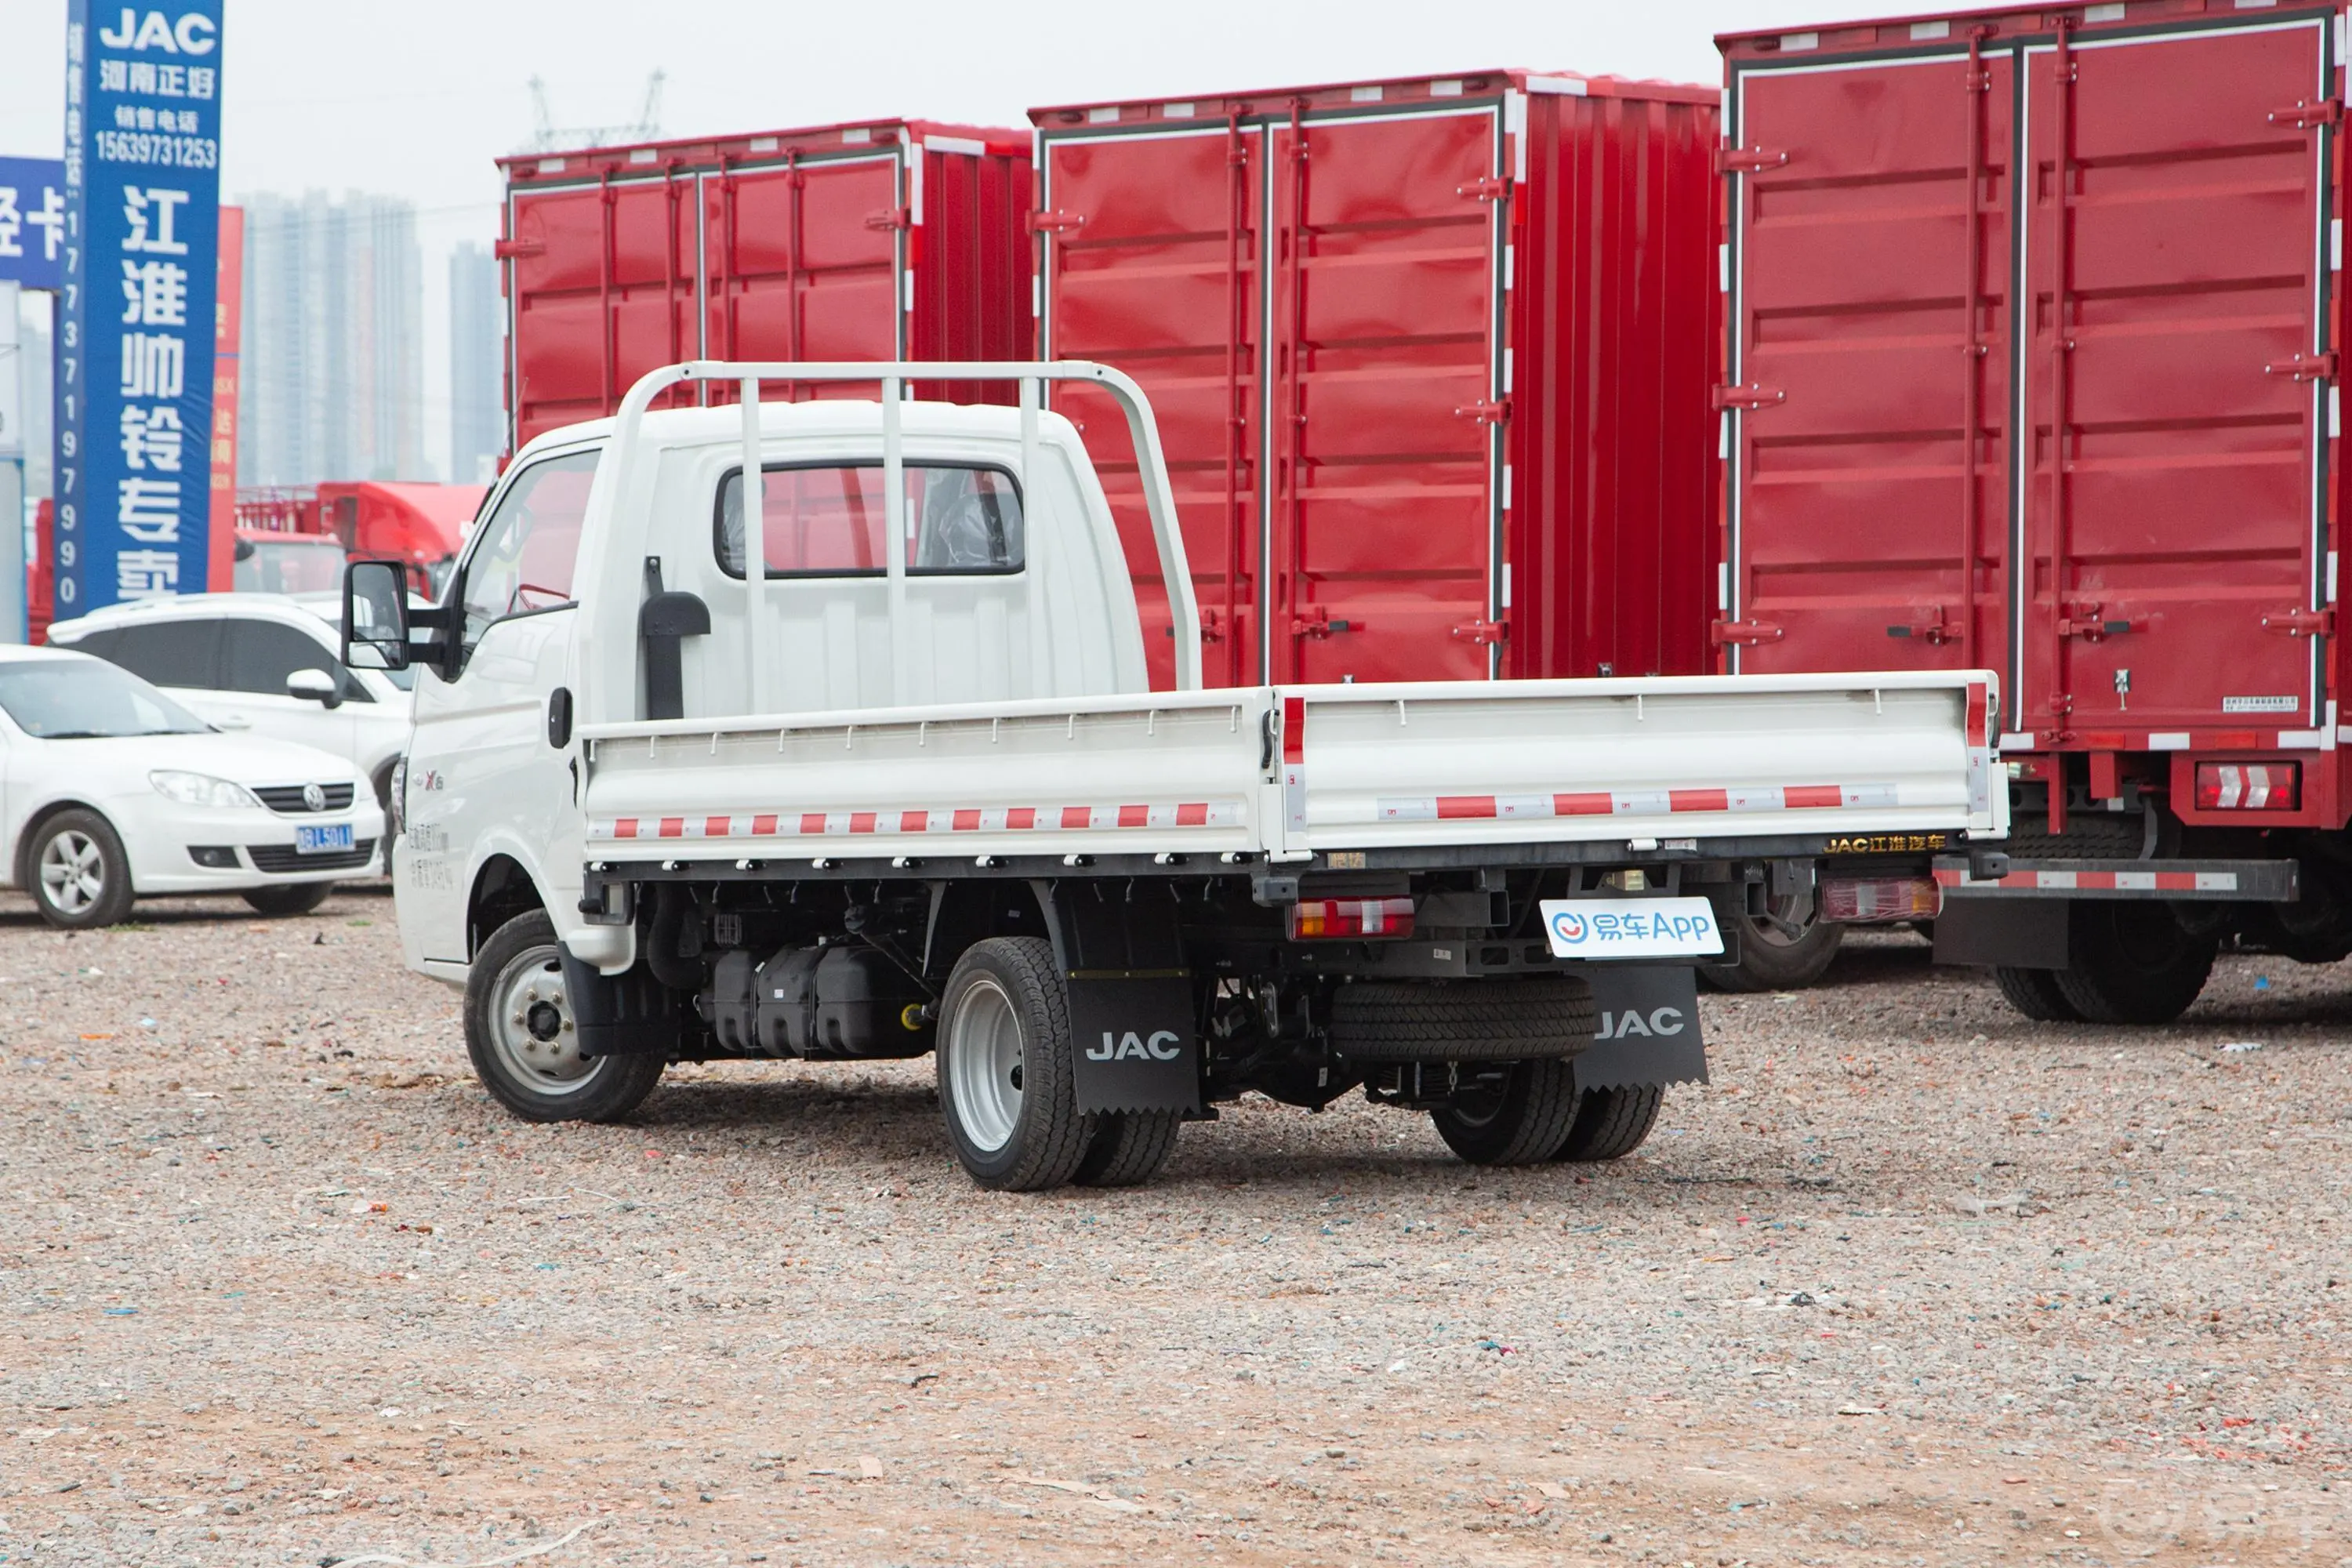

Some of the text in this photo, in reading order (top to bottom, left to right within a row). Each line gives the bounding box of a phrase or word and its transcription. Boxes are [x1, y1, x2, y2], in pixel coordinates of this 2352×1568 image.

[99, 7, 216, 56] JAC
[95, 130, 217, 169] 15639731253
[117, 184, 190, 601] 江淮帅铃专卖
[1592, 912, 1710, 942] 易车App
[1594, 1007, 1685, 1040] JAC
[1086, 1030, 1181, 1062] JAC
